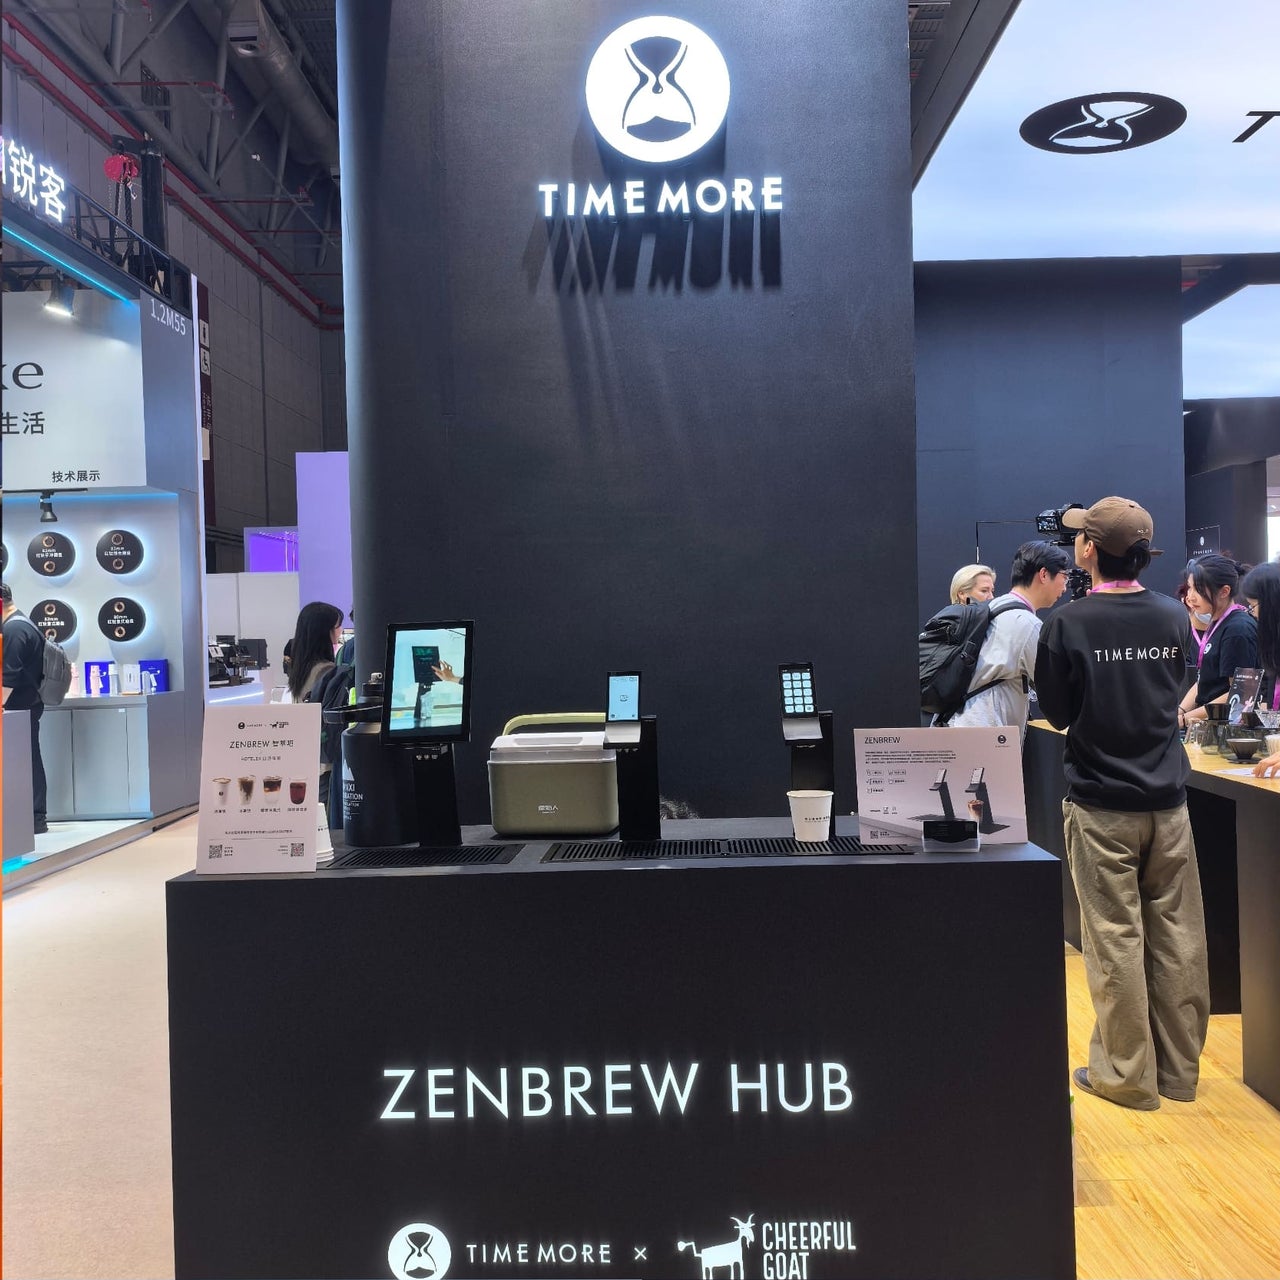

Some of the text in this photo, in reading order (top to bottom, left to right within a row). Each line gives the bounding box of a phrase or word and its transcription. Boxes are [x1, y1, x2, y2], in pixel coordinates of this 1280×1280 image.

[150, 298, 187, 336] 1.2M55
[52, 470, 101, 483] 技术展示
[229, 740, 270, 749] ZENBREW
[864, 736, 901, 744] ZENBREW
[380, 1061, 854, 1119] ZENBREW HUB
[762, 1221, 857, 1252] CHEERFUL
[763, 1251, 809, 1280] GOAT
